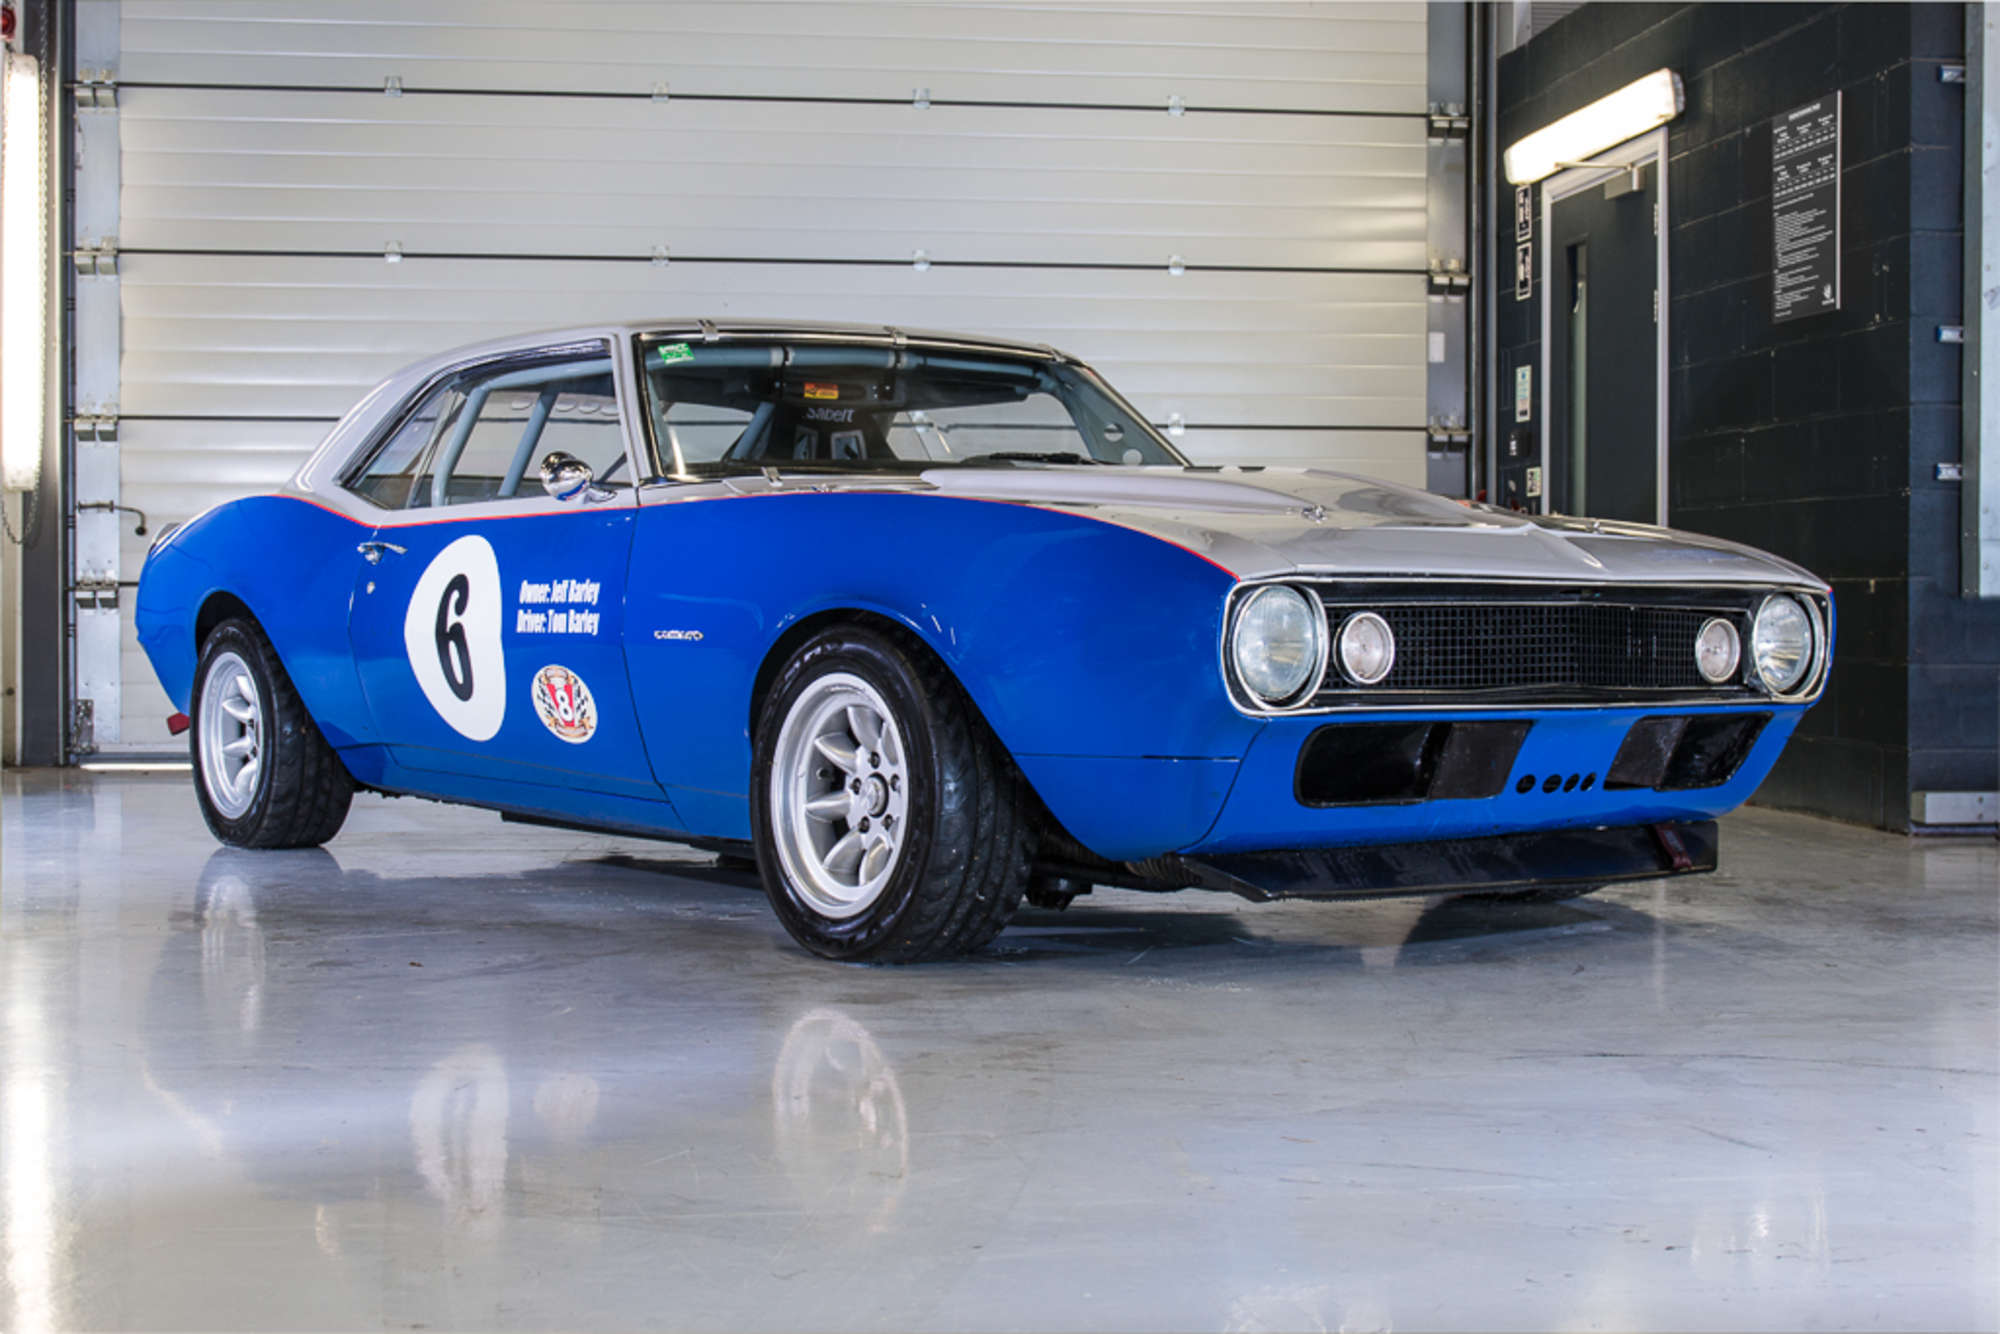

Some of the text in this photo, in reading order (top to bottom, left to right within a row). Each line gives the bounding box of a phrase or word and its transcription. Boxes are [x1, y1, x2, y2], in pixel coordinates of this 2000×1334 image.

[519, 578, 601, 606] Owner: Jeff Barley
[517, 609, 601, 636] Driver: Tom Barley
[435, 573, 474, 702] 6
